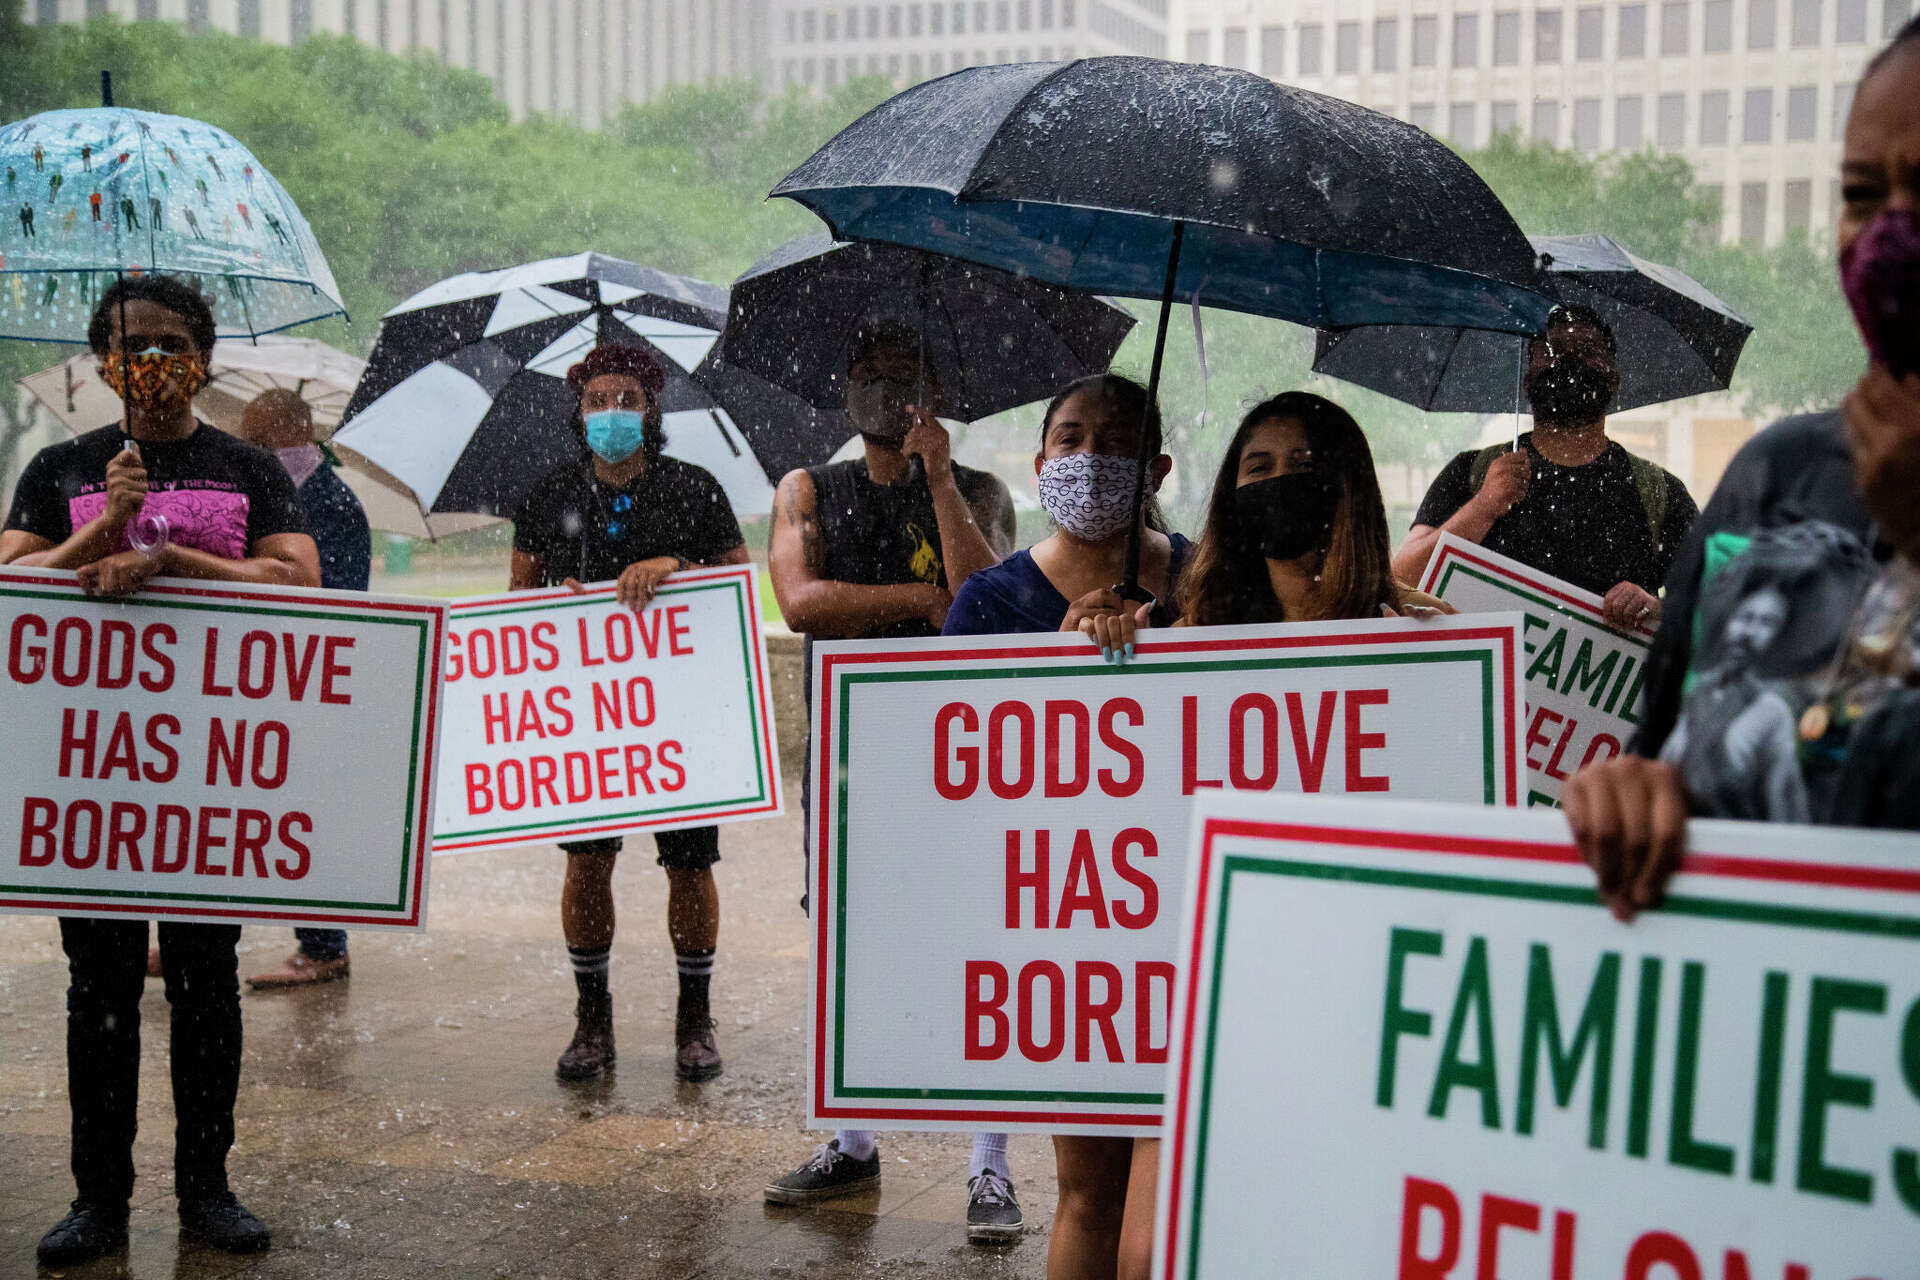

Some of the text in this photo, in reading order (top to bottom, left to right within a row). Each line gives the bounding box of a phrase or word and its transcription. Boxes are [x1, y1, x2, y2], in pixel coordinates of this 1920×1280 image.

[8, 614, 356, 705] GODS LOVE
[444, 604, 694, 682] GODS LOVE
[58, 708, 291, 790] HAS NO
[482, 676, 656, 745] HAS NO
[934, 689, 1391, 801] GODS LOVE
[465, 739, 686, 816] BORDERS
[18, 797, 313, 881] BORDERS
[1005, 827, 1159, 931] HAS
[964, 960, 1177, 1064] BORD
